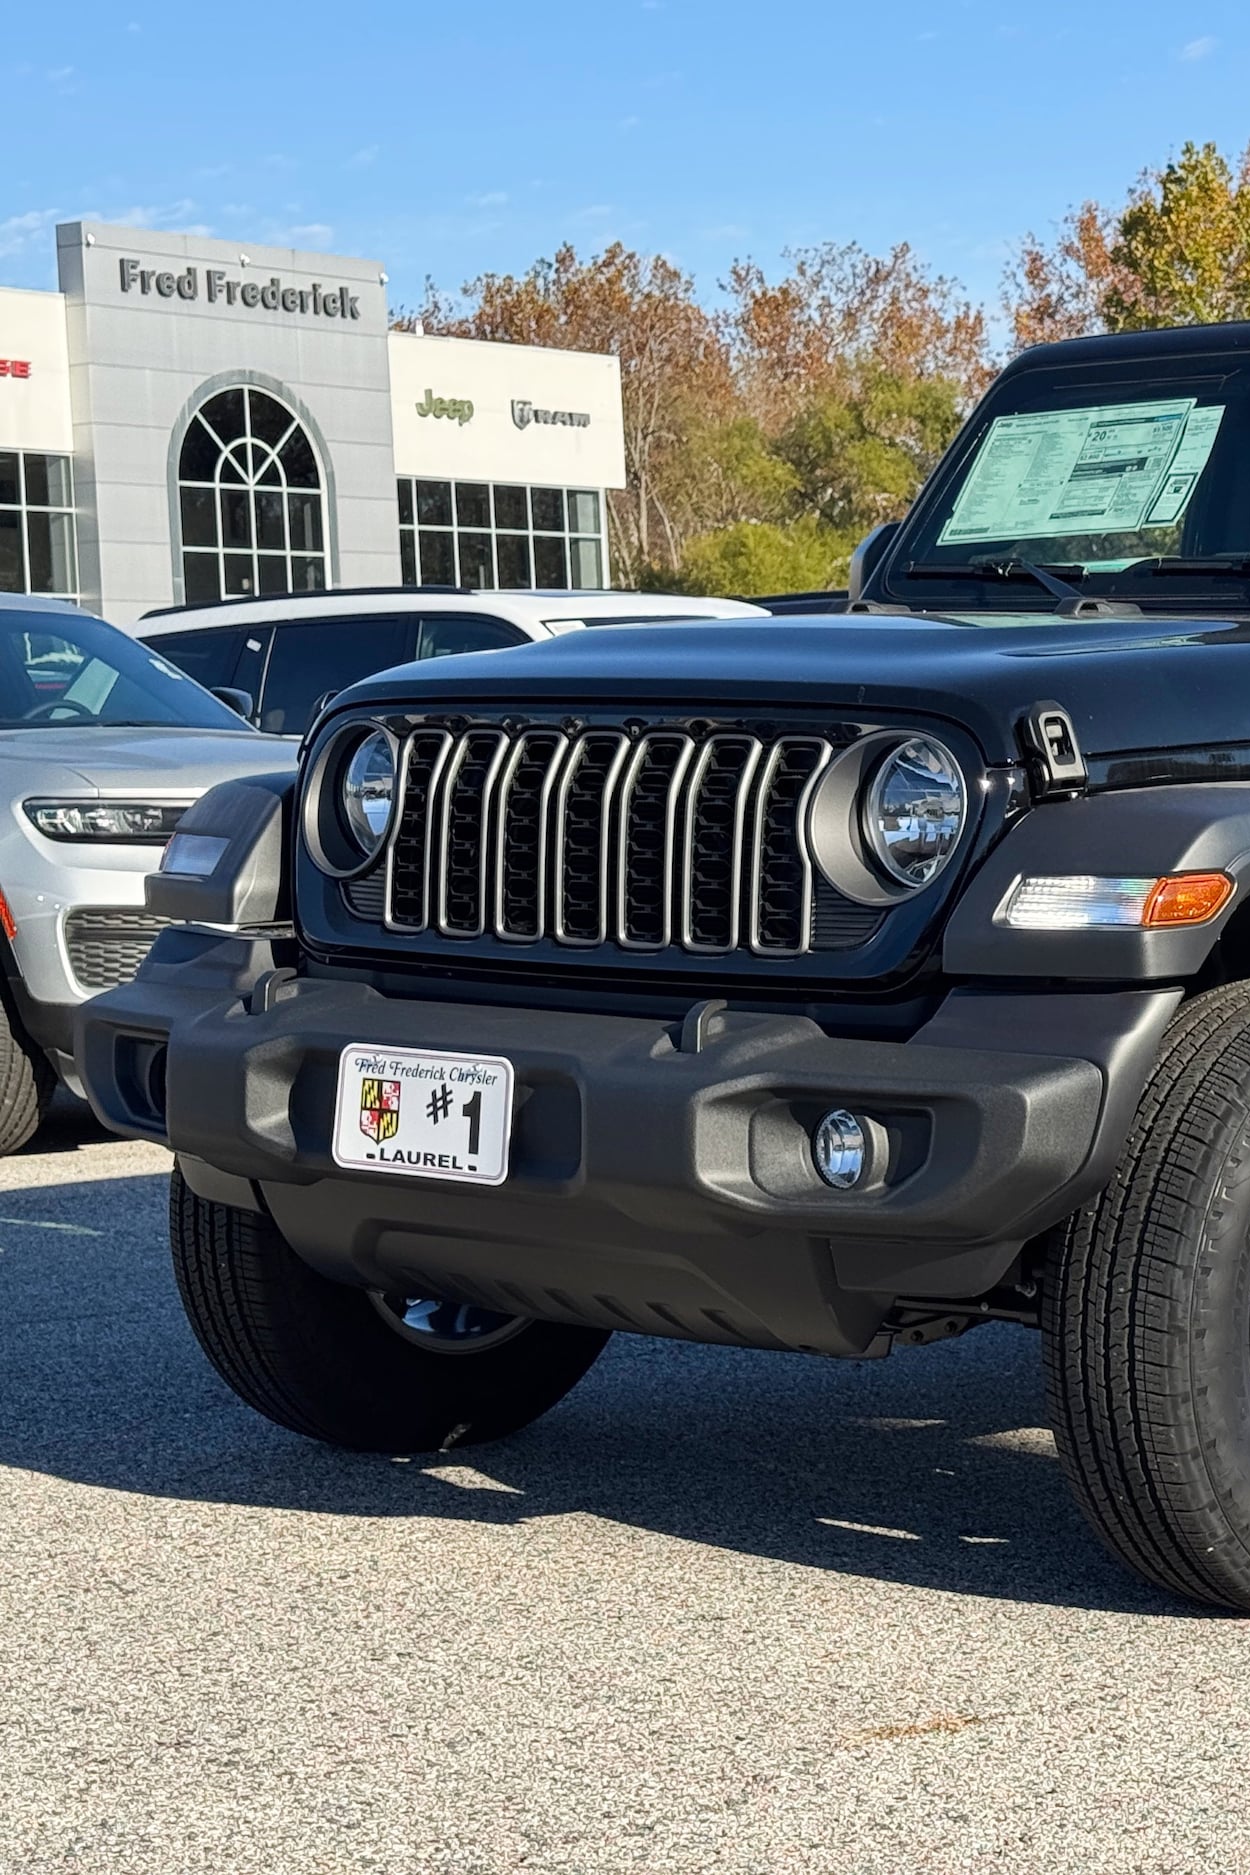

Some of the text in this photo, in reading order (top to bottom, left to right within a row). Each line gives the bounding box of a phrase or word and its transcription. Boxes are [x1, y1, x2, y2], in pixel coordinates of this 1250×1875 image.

[119, 257, 360, 320] Fred Frederick
[415, 388, 474, 427] Jeep
[534, 409, 591, 428] RAM
[355, 1057, 498, 1086] Fred Frederick Chrysler
[379, 1147, 463, 1170] LAUREL
